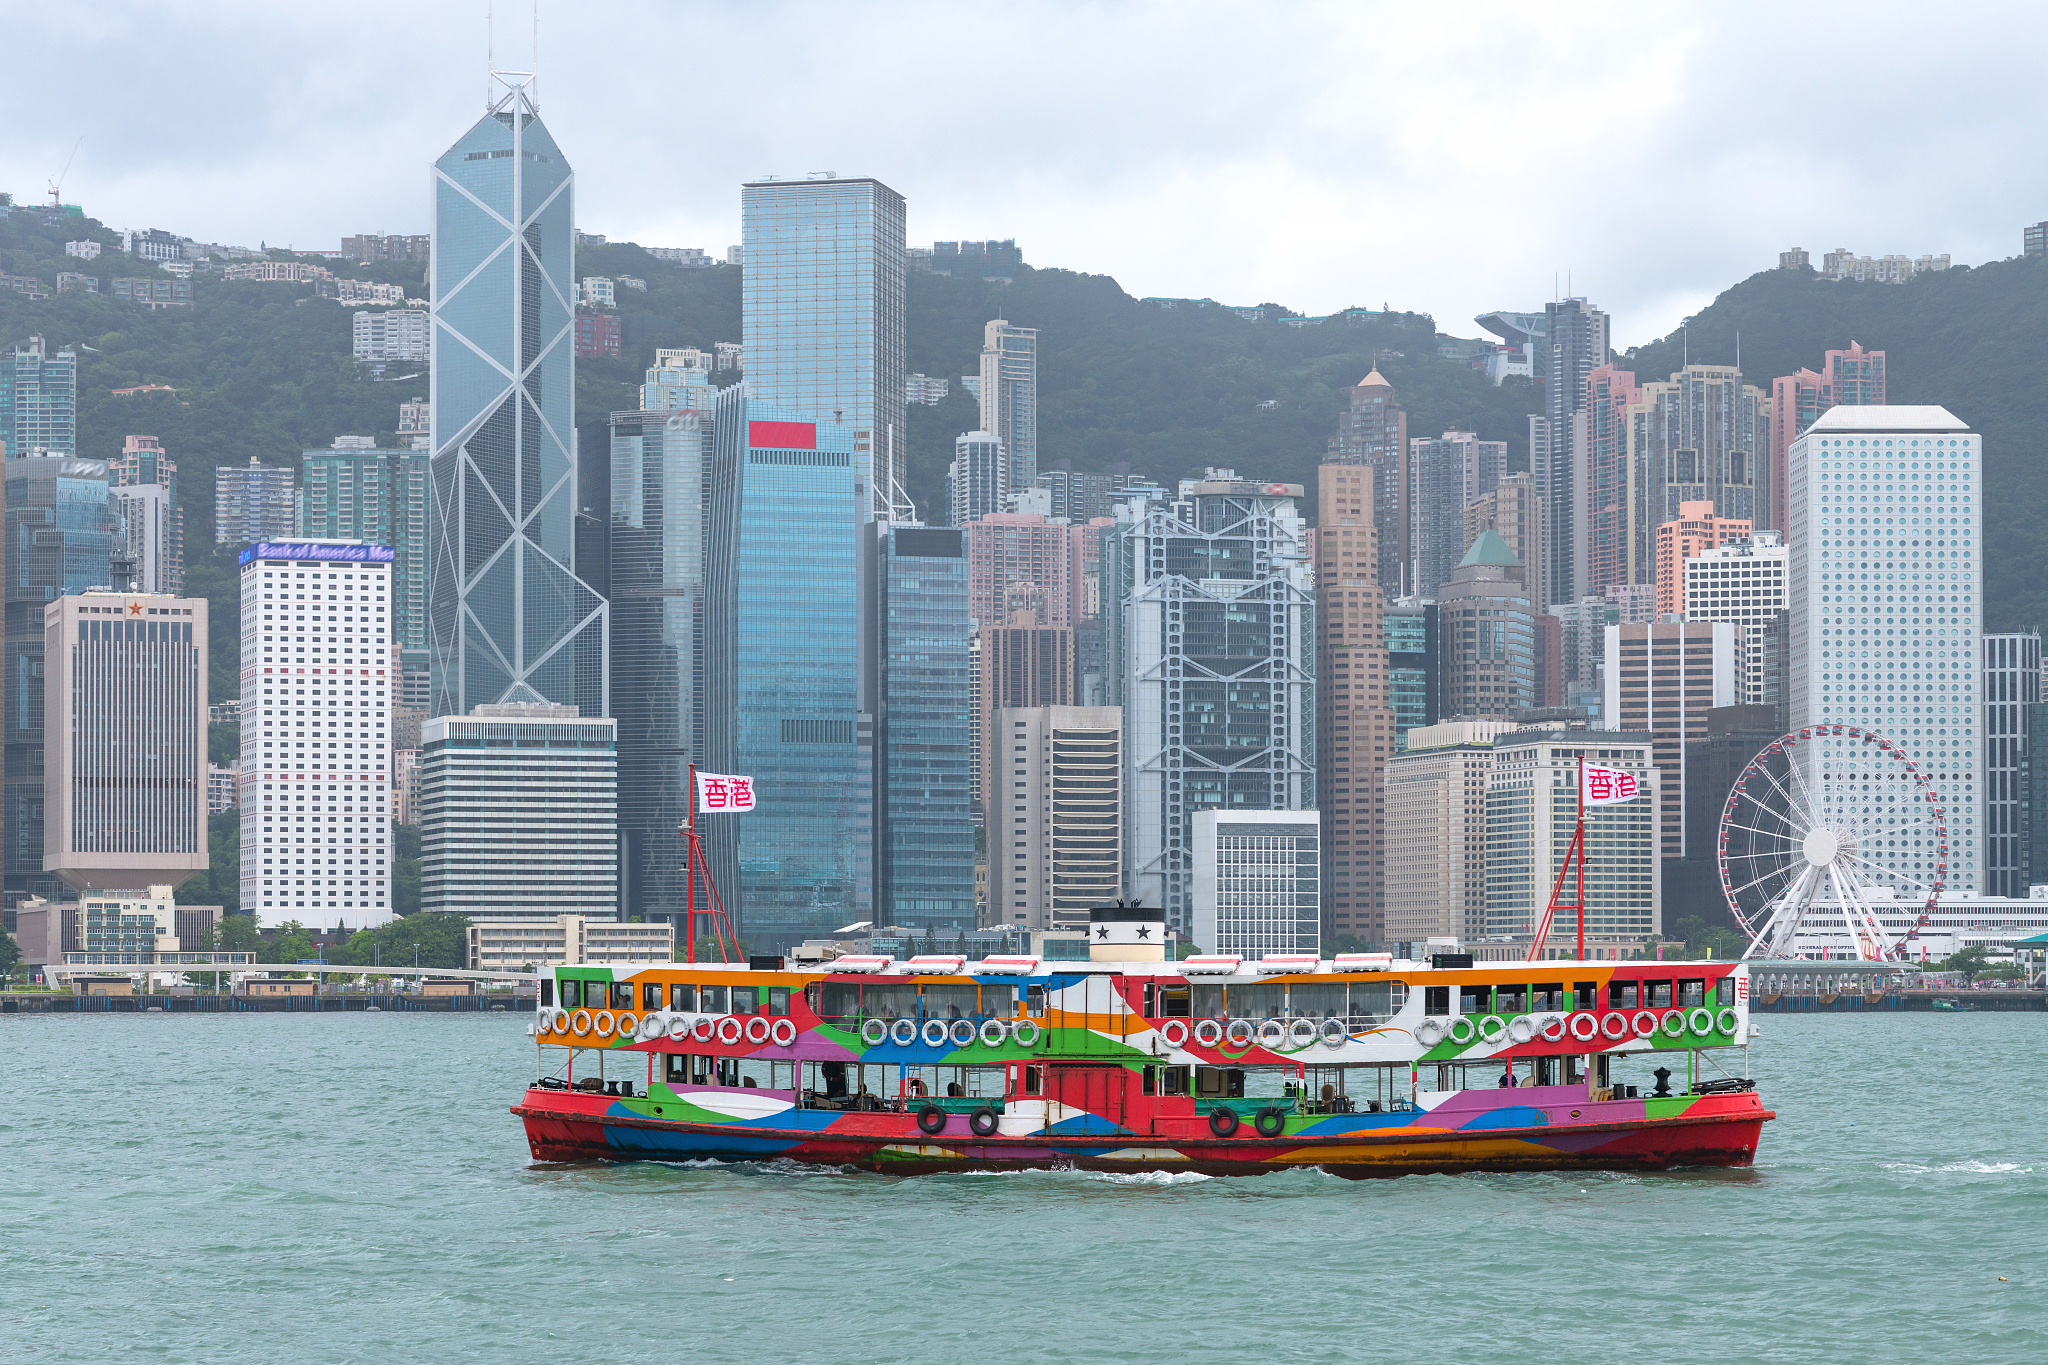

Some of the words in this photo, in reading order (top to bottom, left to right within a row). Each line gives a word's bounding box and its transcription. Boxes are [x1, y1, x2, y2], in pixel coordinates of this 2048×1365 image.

[258, 543, 291, 557] Bank
[309, 544, 367, 559] America
[705, 778, 753, 807] 香港
[1589, 769, 1638, 799] 香港
[1534, 1110, 1554, 1123] A31
